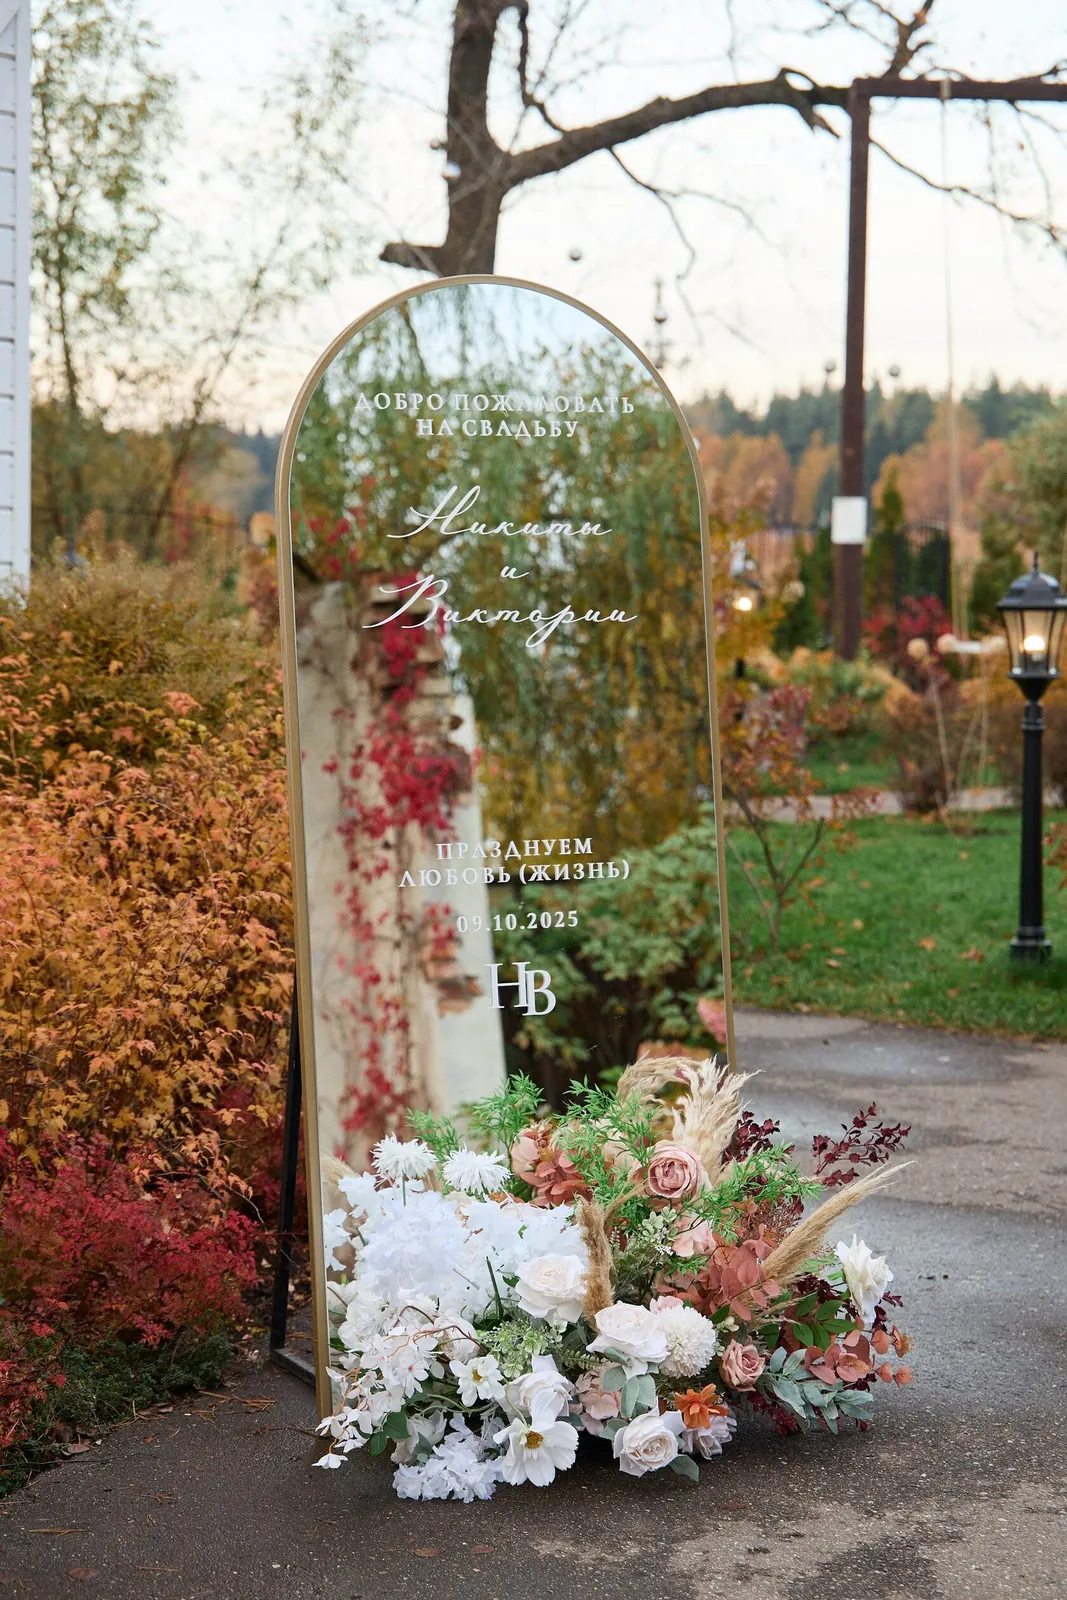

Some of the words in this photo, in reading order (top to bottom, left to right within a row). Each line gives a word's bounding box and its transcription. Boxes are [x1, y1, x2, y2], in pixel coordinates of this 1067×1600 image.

[354, 391, 444, 413] ДОБРО
[453, 393, 635, 415] ПОЖАЛОВАТЬ
[416, 418, 454, 437] НА
[461, 418, 579, 440] СВАДЬБУ
[387, 485, 612, 538] Никиты
[500, 565, 529, 579] и
[362, 574, 638, 648] Виктории
[436, 837, 593, 861] ПРАЗДНУЕМ
[398, 866, 512, 888] ЛЮБОВЬ
[519, 859, 630, 885] (ЖИЗНЬ)
[456, 909, 579, 933] 09.10.2025
